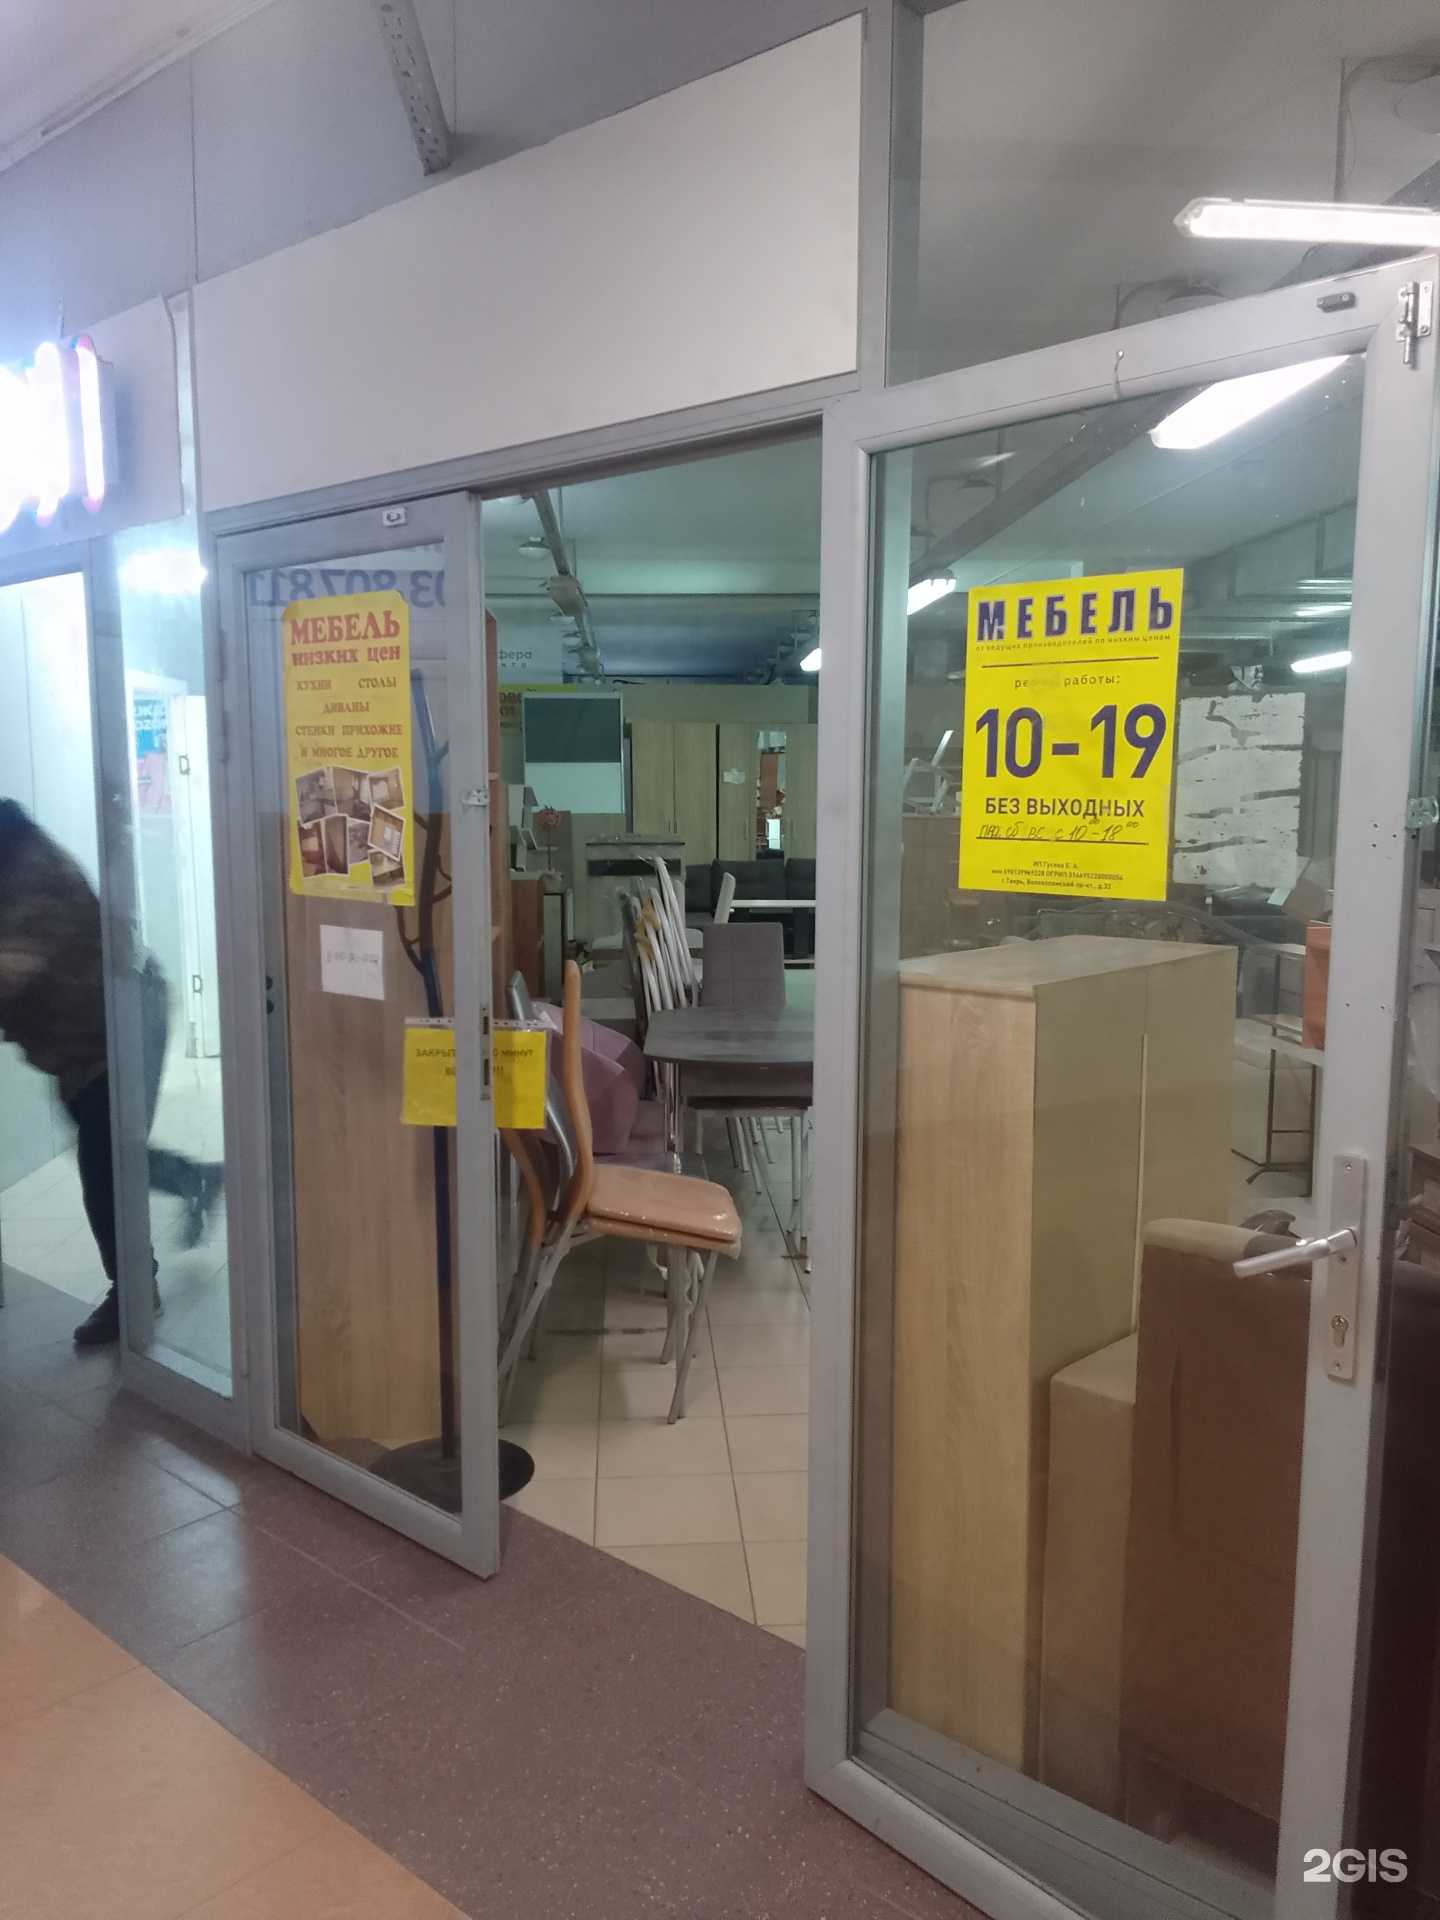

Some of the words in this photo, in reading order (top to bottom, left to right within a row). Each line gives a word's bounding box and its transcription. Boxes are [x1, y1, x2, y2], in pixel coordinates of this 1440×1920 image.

[977, 588, 1172, 641] МЕБЕЛЬ
[290, 610, 401, 646] МЕБЕЛЬ
[297, 680, 332, 691] КУХНИ
[358, 677, 397, 689] СТОЛЫ
[1064, 674, 1121, 690] работы:
[322, 702, 370, 714] ДИВАНЫ
[295, 726, 335, 737] СТЕНКИ
[300, 747, 308, 758] И
[356, 747, 399, 759] ДРУГОЕ
[985, 797, 1020, 815] БЕЗ
[1027, 798, 1145, 820] ВЫХОДНЫХ
